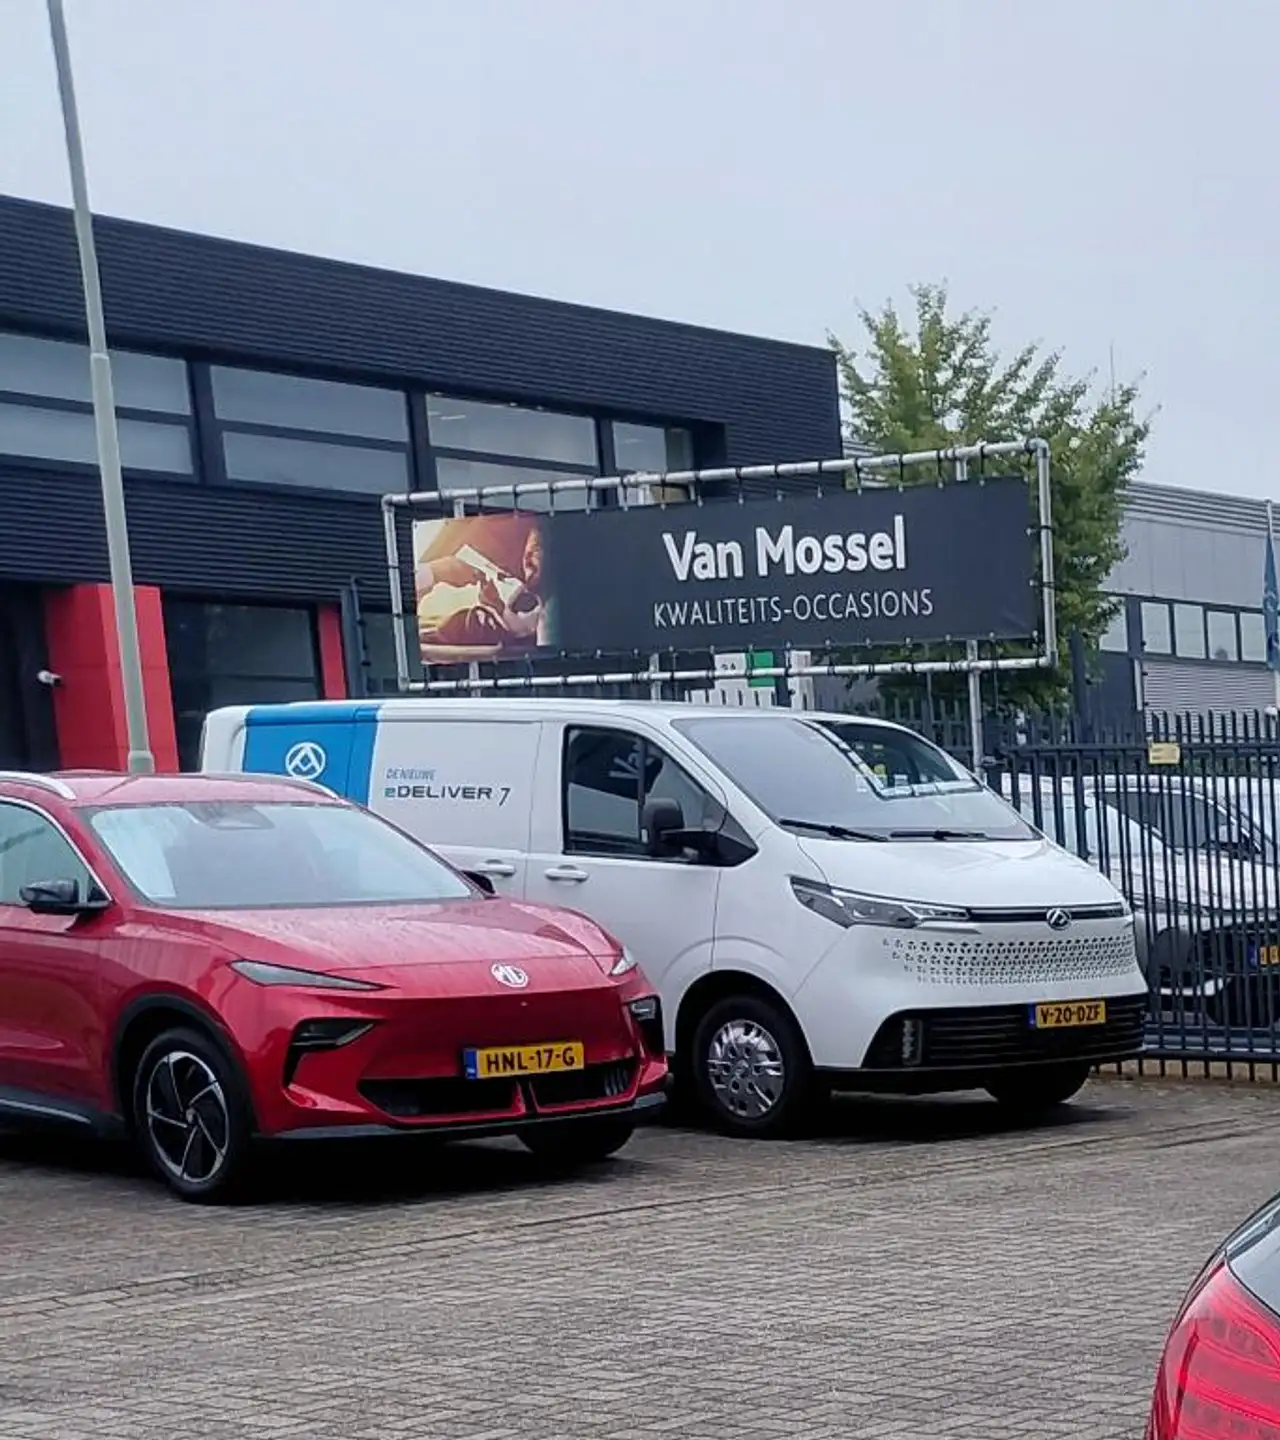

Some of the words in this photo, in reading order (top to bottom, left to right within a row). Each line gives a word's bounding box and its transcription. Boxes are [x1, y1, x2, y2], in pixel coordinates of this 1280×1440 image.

[662, 531, 744, 581] Van
[755, 514, 906, 577] Mossel
[653, 589, 934, 628] KWALITEITS-OCCASIONS
[384, 785, 492, 800] eDELIVER
[499, 787, 511, 806] 7
[486, 1046, 576, 1074] HNL-17-G
